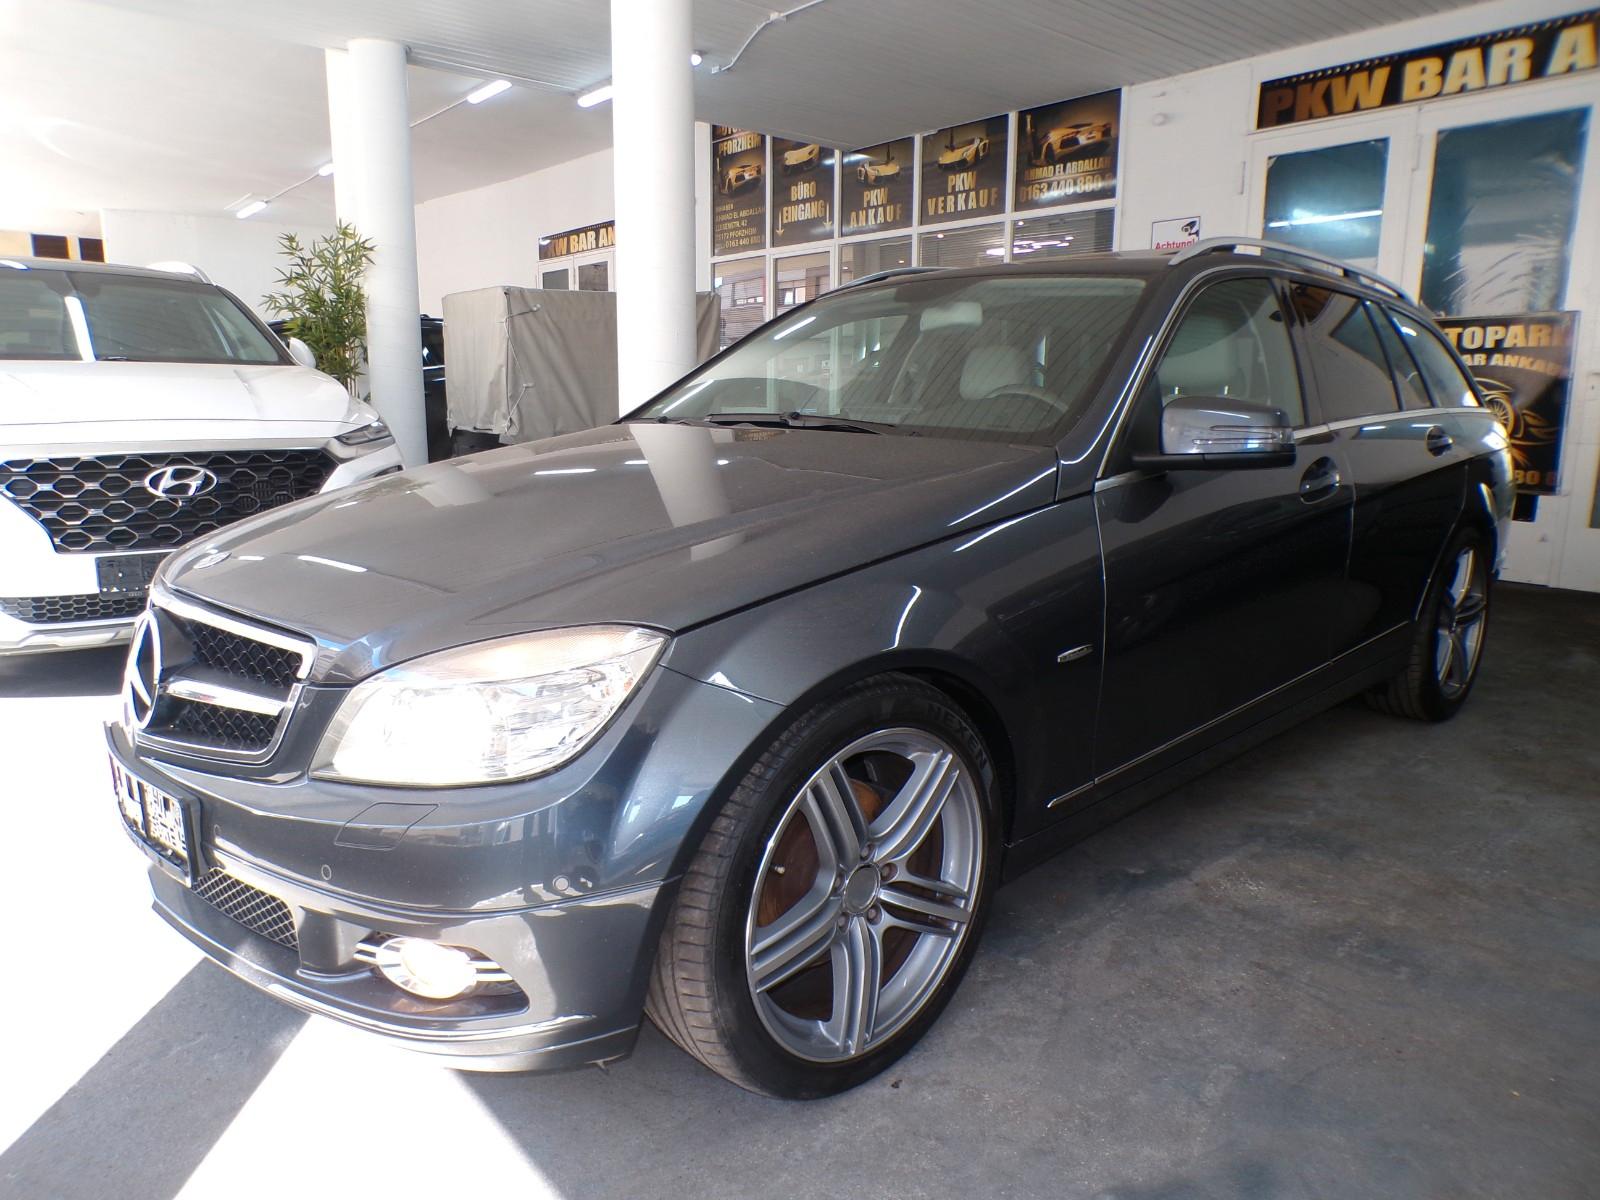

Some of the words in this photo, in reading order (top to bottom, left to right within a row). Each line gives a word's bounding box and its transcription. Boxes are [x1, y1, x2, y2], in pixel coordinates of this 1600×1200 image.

[1262, 66, 1391, 128] PKW
[1402, 38, 1534, 101] BAR
[790, 181, 817, 202] BÜRO
[947, 171, 976, 193] PKW
[863, 187, 889, 208] PKW
[927, 187, 998, 216] VERKAUF
[782, 200, 825, 224] EINGANG
[850, 203, 903, 227] ANKAUF
[570, 231, 595, 253] BAR
